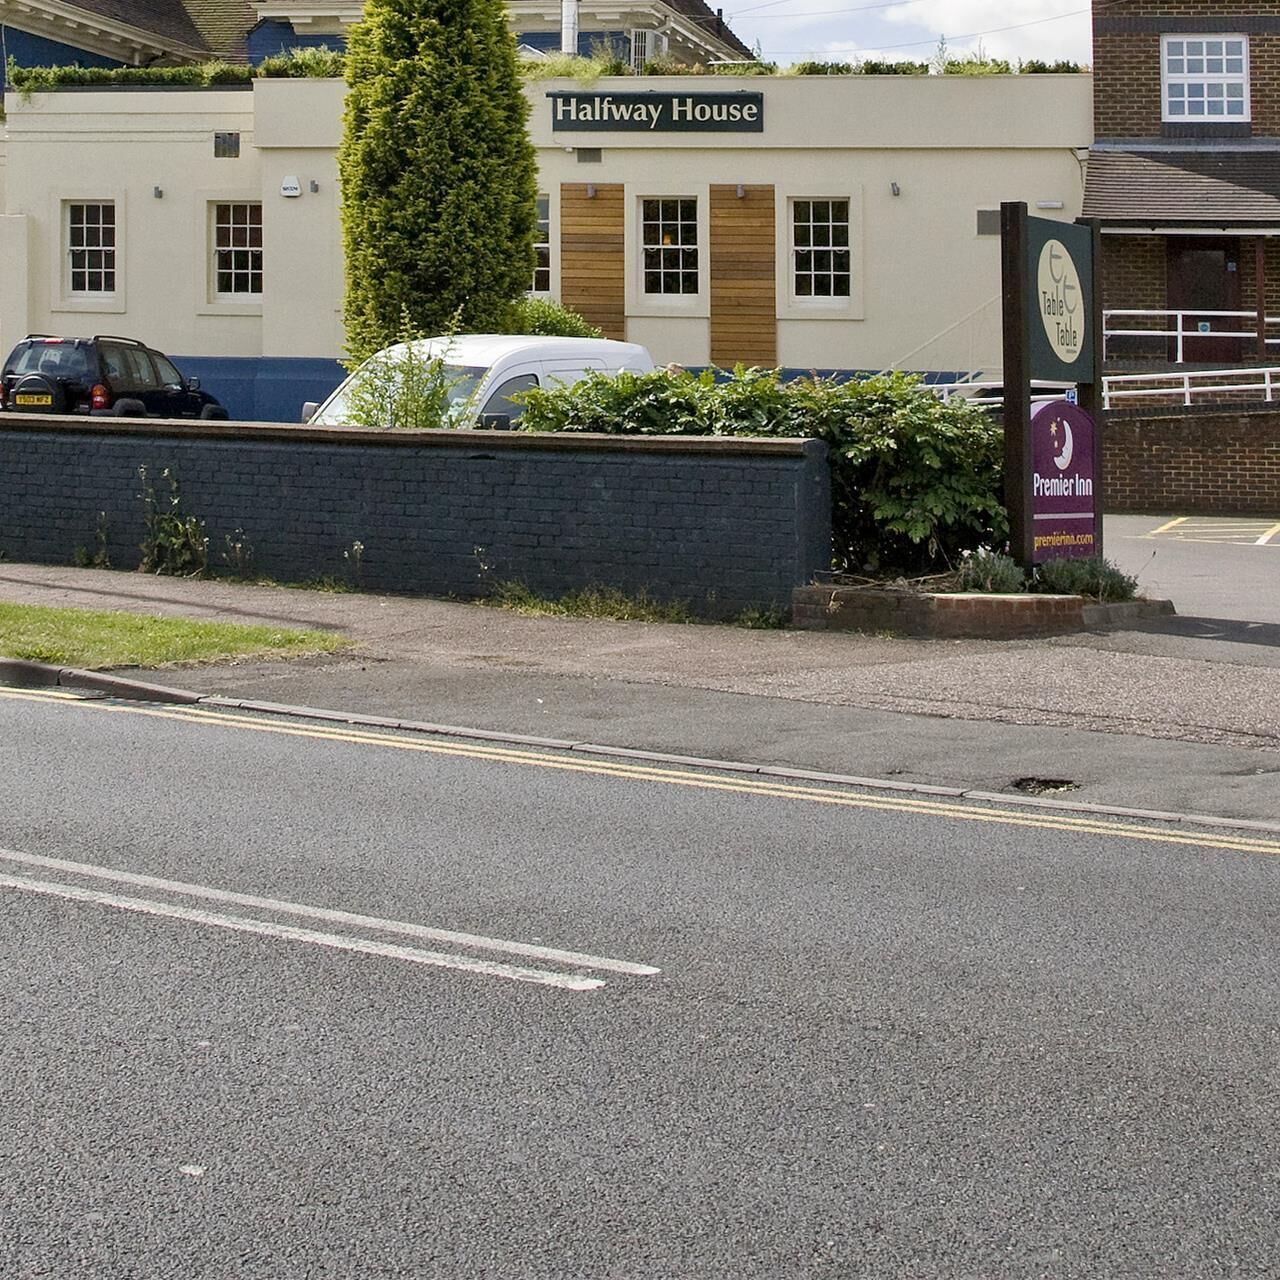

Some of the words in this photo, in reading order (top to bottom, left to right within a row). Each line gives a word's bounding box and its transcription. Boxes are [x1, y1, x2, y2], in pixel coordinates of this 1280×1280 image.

[556, 96, 663, 129] Halfway
[671, 97, 758, 121] House
[1042, 287, 1064, 317] Table
[1055, 318, 1077, 347] Table
[1033, 472, 1074, 497] Premier
[1075, 472, 1093, 496] Inn
[1034, 530, 1094, 551] premierinn.com
